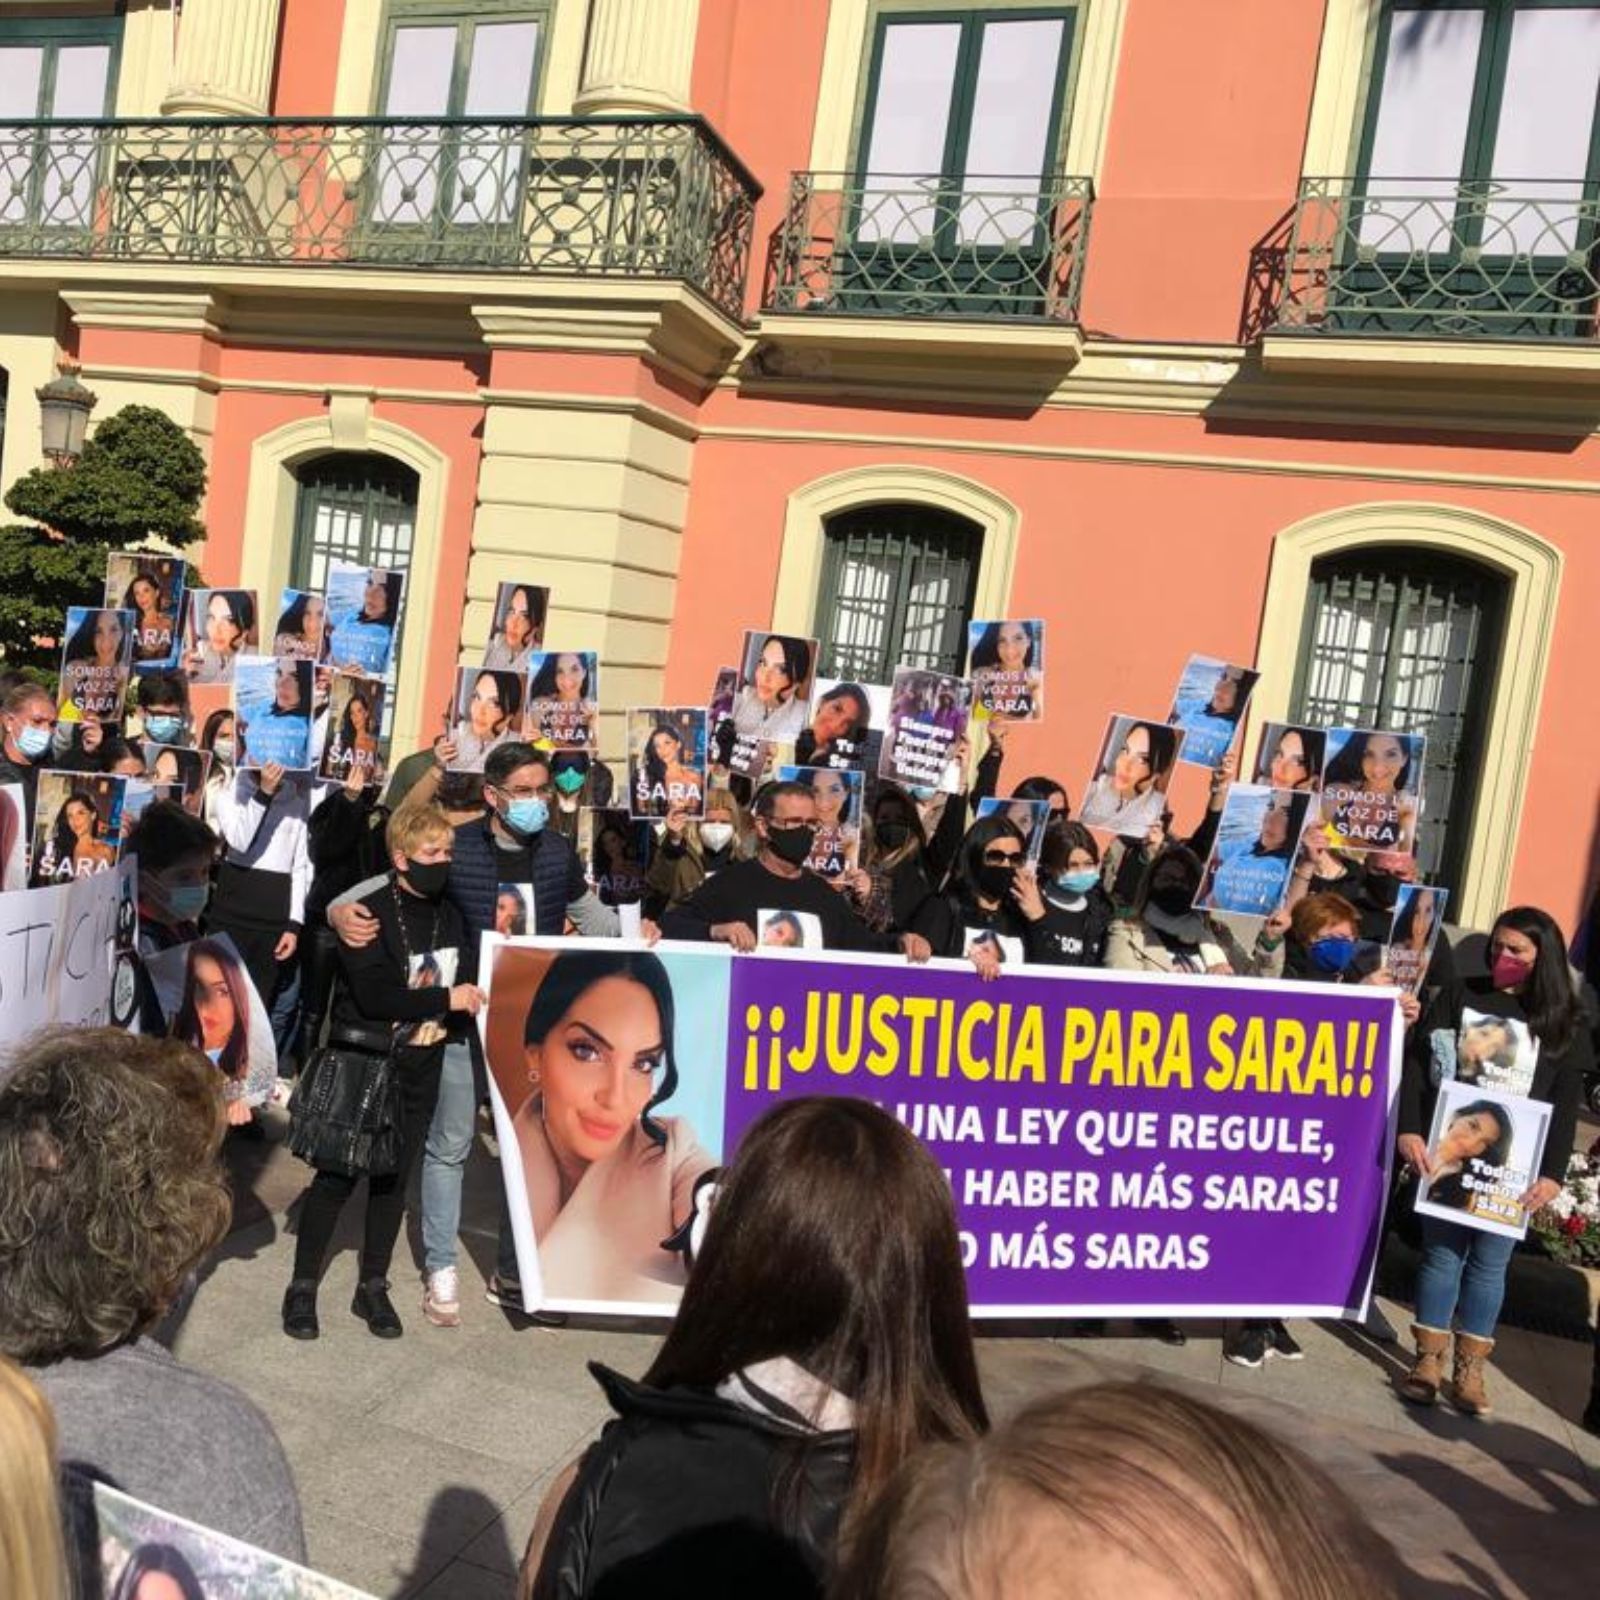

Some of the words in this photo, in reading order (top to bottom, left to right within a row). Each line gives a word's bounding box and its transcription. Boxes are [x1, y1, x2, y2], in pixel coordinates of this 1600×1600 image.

[132, 628, 172, 646] ARA
[65, 664, 113, 678] SOMOS
[972, 670, 1020, 681] SOMOS
[982, 685, 1008, 695] VOZ
[74, 697, 114, 712] SARA
[984, 700, 1029, 712] SARA
[543, 729, 586, 740] SARA
[328, 744, 375, 767] SARA
[636, 782, 702, 801] SARA
[1325, 787, 1386, 805] SOMOS
[1336, 805, 1371, 820] VOZ
[1376, 810, 1398, 822] DE
[1336, 822, 1394, 842] SARA
[39, 854, 110, 879] SARA
[803, 856, 841, 871] ARA
[745, 990, 1044, 1090] ¡¡JUSTICIA
[1062, 1008, 1190, 1088] PARA
[1206, 1016, 1377, 1097] SARA!!
[996, 1107, 1068, 1145] LEY
[1076, 1109, 1158, 1155] QUE
[1169, 1113, 1334, 1162] REGULE,
[963, 1168, 1099, 1209] HABER
[1110, 1162, 1193, 1210] MÁS
[1203, 1175, 1338, 1213] SARAS!
[990, 1221, 1074, 1270] MÁS
[1085, 1232, 1210, 1270] SARAS
